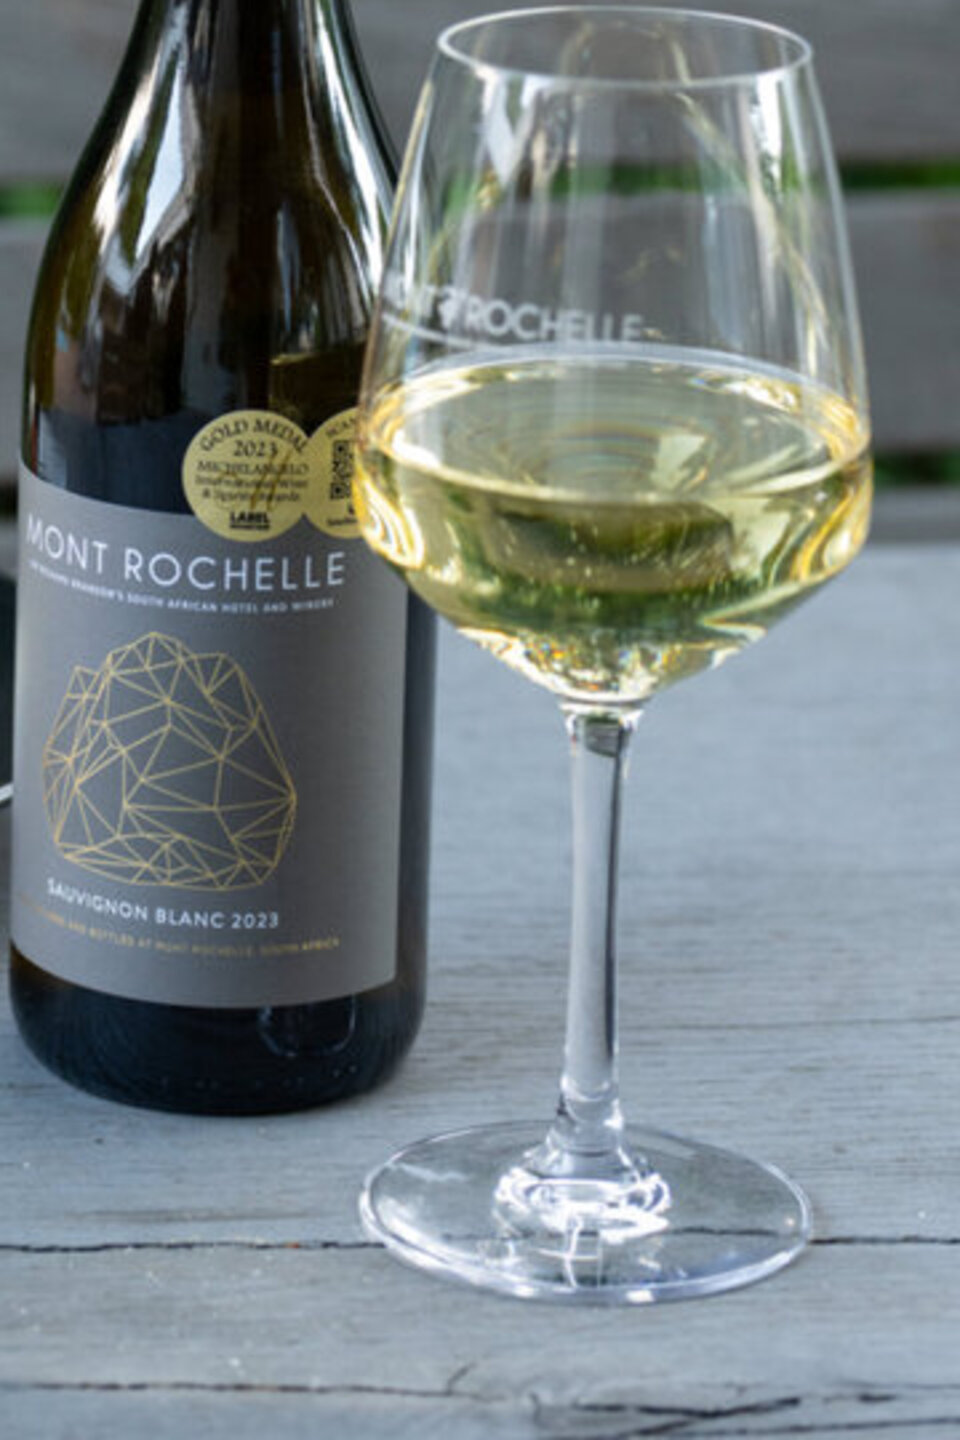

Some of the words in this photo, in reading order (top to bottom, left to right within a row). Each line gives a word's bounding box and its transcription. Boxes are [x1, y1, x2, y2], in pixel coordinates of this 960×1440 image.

[200, 419, 248, 452] GOLD
[253, 417, 307, 453] MEDAL
[234, 439, 279, 457] 2023
[26, 513, 108, 574] MONT
[124, 547, 345, 591] ROCHELLE
[47, 877, 148, 921] SAUVIGNON
[154, 907, 226, 930] BLANC
[231, 910, 280, 929] 2023
